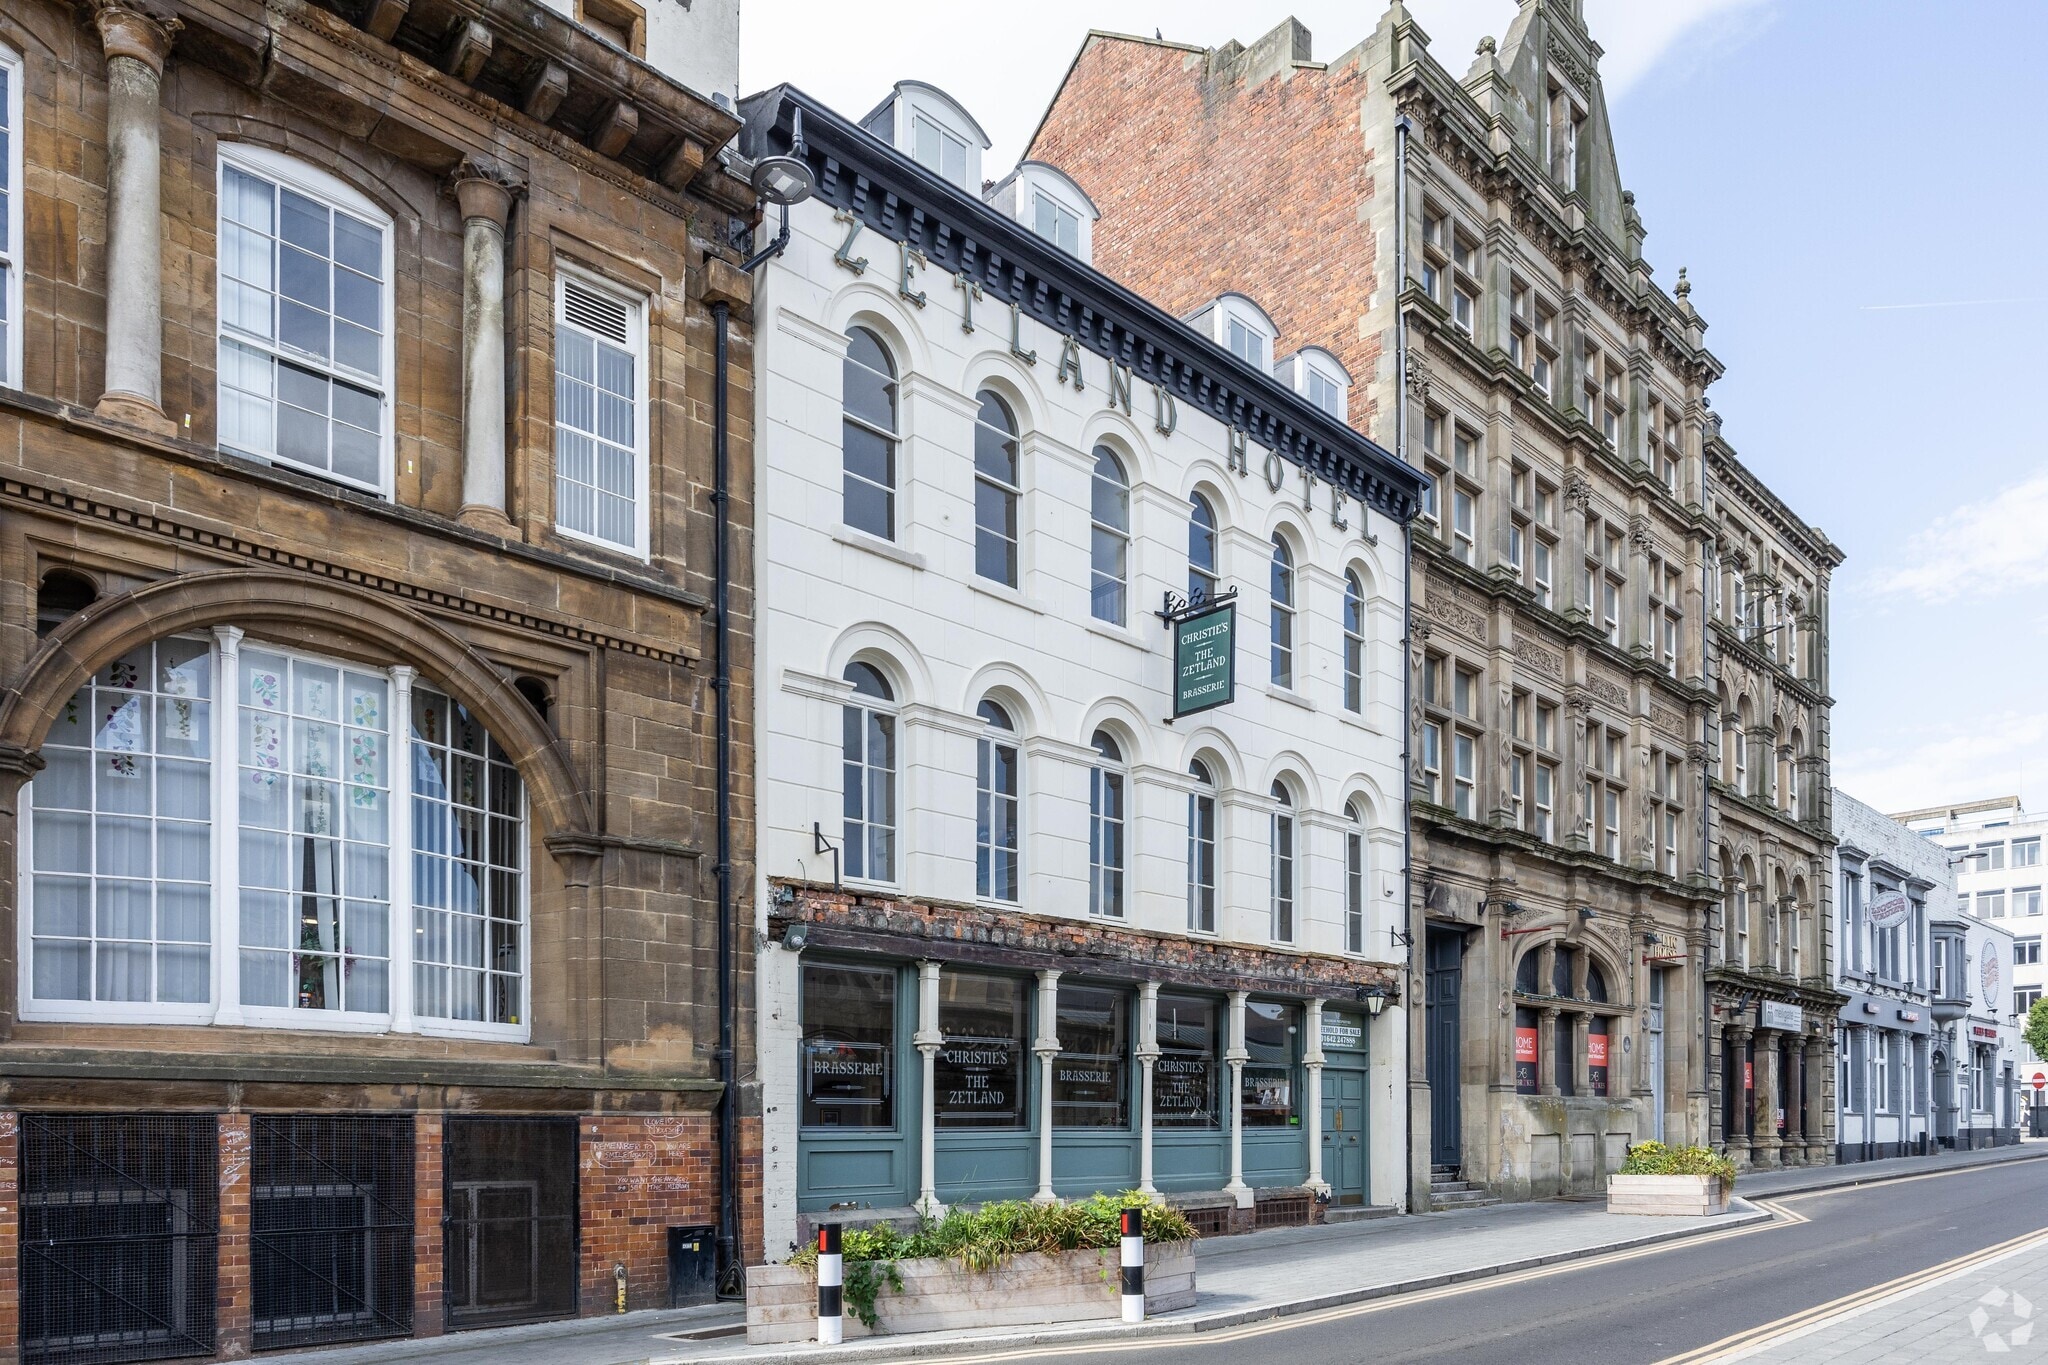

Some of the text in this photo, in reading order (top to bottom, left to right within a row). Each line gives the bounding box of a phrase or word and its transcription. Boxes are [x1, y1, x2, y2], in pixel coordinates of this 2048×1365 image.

[833, 207, 1379, 547] ZETLAND HOTEL
[1181, 621, 1229, 646] CHRISTIE'S
[1195, 647, 1214, 662] THE
[1182, 655, 1226, 677] ZETLAND
[1182, 680, 1225, 700] BRASSERIE
[1321, 1026, 1361, 1036] EEHOLD FOR SALE
[946, 1050, 1008, 1065] CHRISTIE'S
[813, 1060, 883, 1076] BRASSERIE
[1158, 1060, 1204, 1073] CHRISTIE'S
[965, 1074, 989, 1089] THE
[1060, 1069, 1111, 1083] BRASSERIE
[1172, 1082, 1190, 1094] THE
[949, 1090, 1004, 1105] ZETLAND
[1160, 1095, 1202, 1108] ZETLAND
[594, 1142, 640, 1150] REMEMBER
